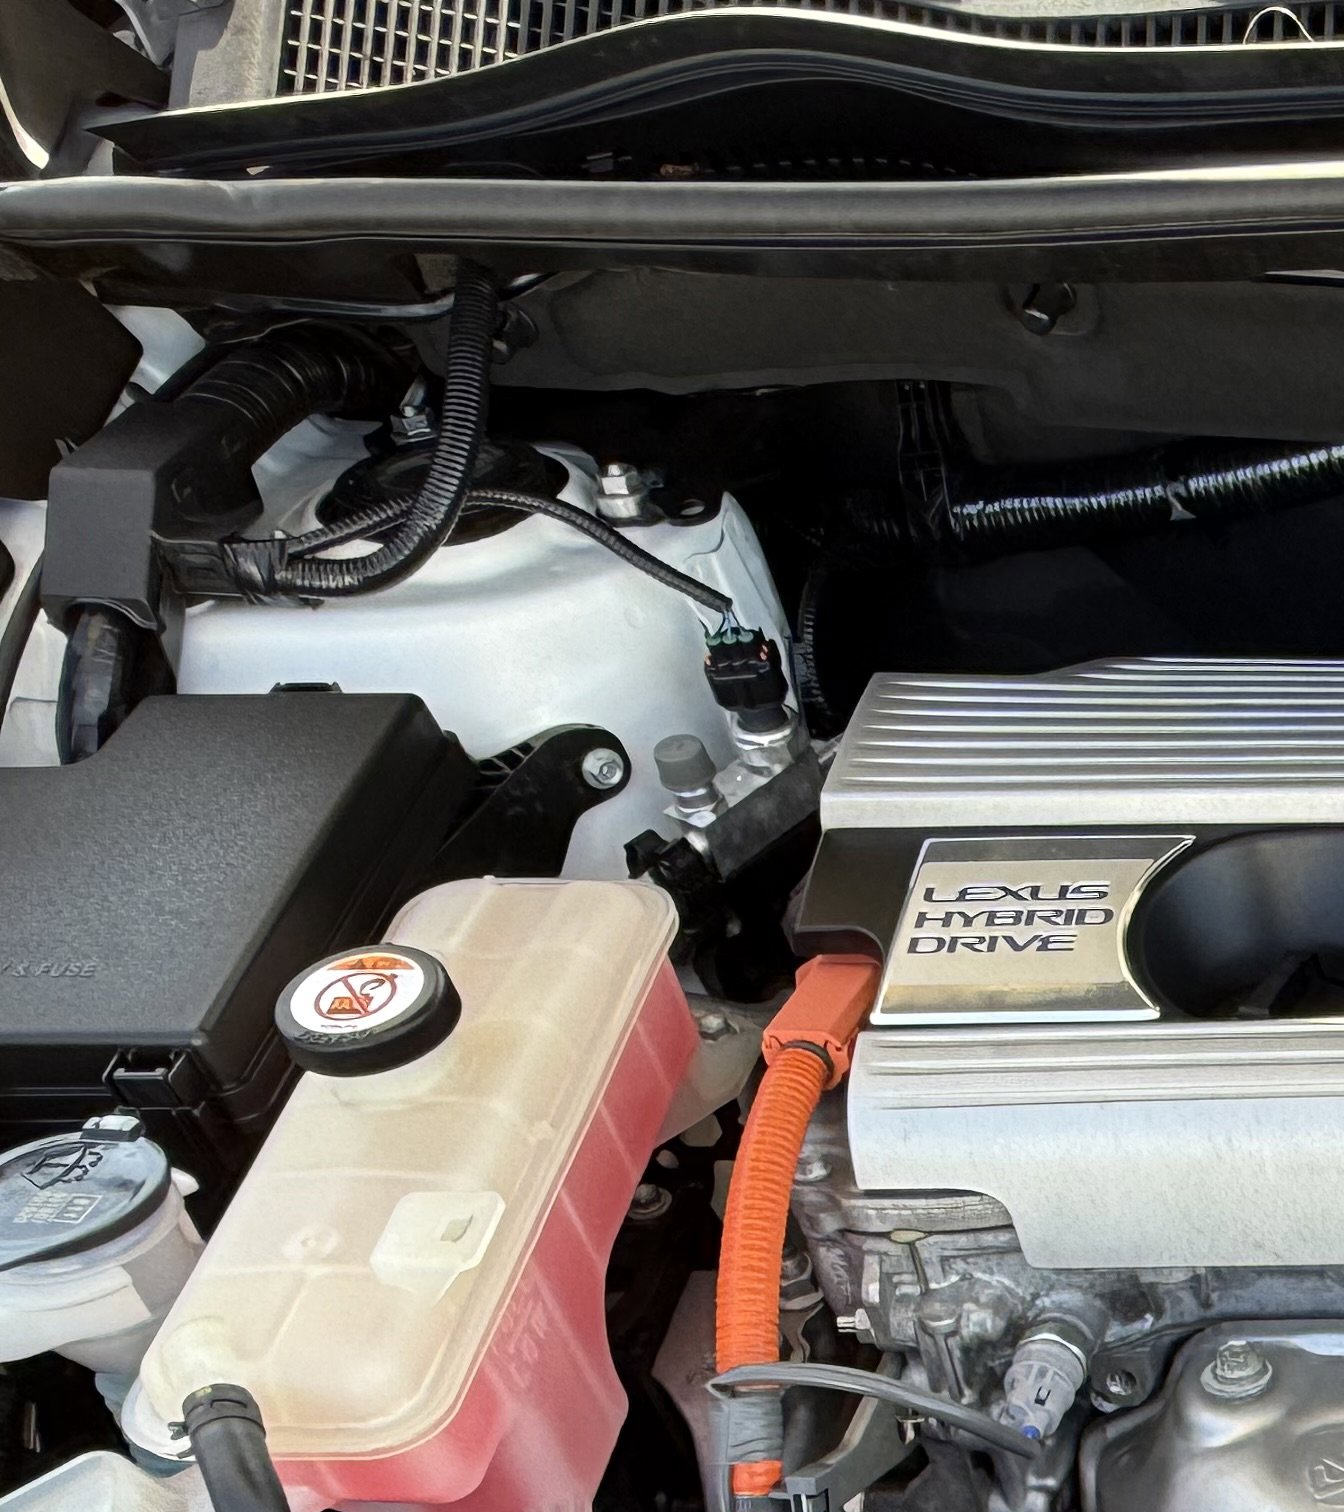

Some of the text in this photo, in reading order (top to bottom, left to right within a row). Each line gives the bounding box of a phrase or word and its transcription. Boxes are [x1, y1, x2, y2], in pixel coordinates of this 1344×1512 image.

[923, 882, 1111, 903] LEXUS
[914, 907, 1114, 929] HYBRID
[907, 933, 1078, 955] DRIVE
[34, 961, 97, 978] FUSE
